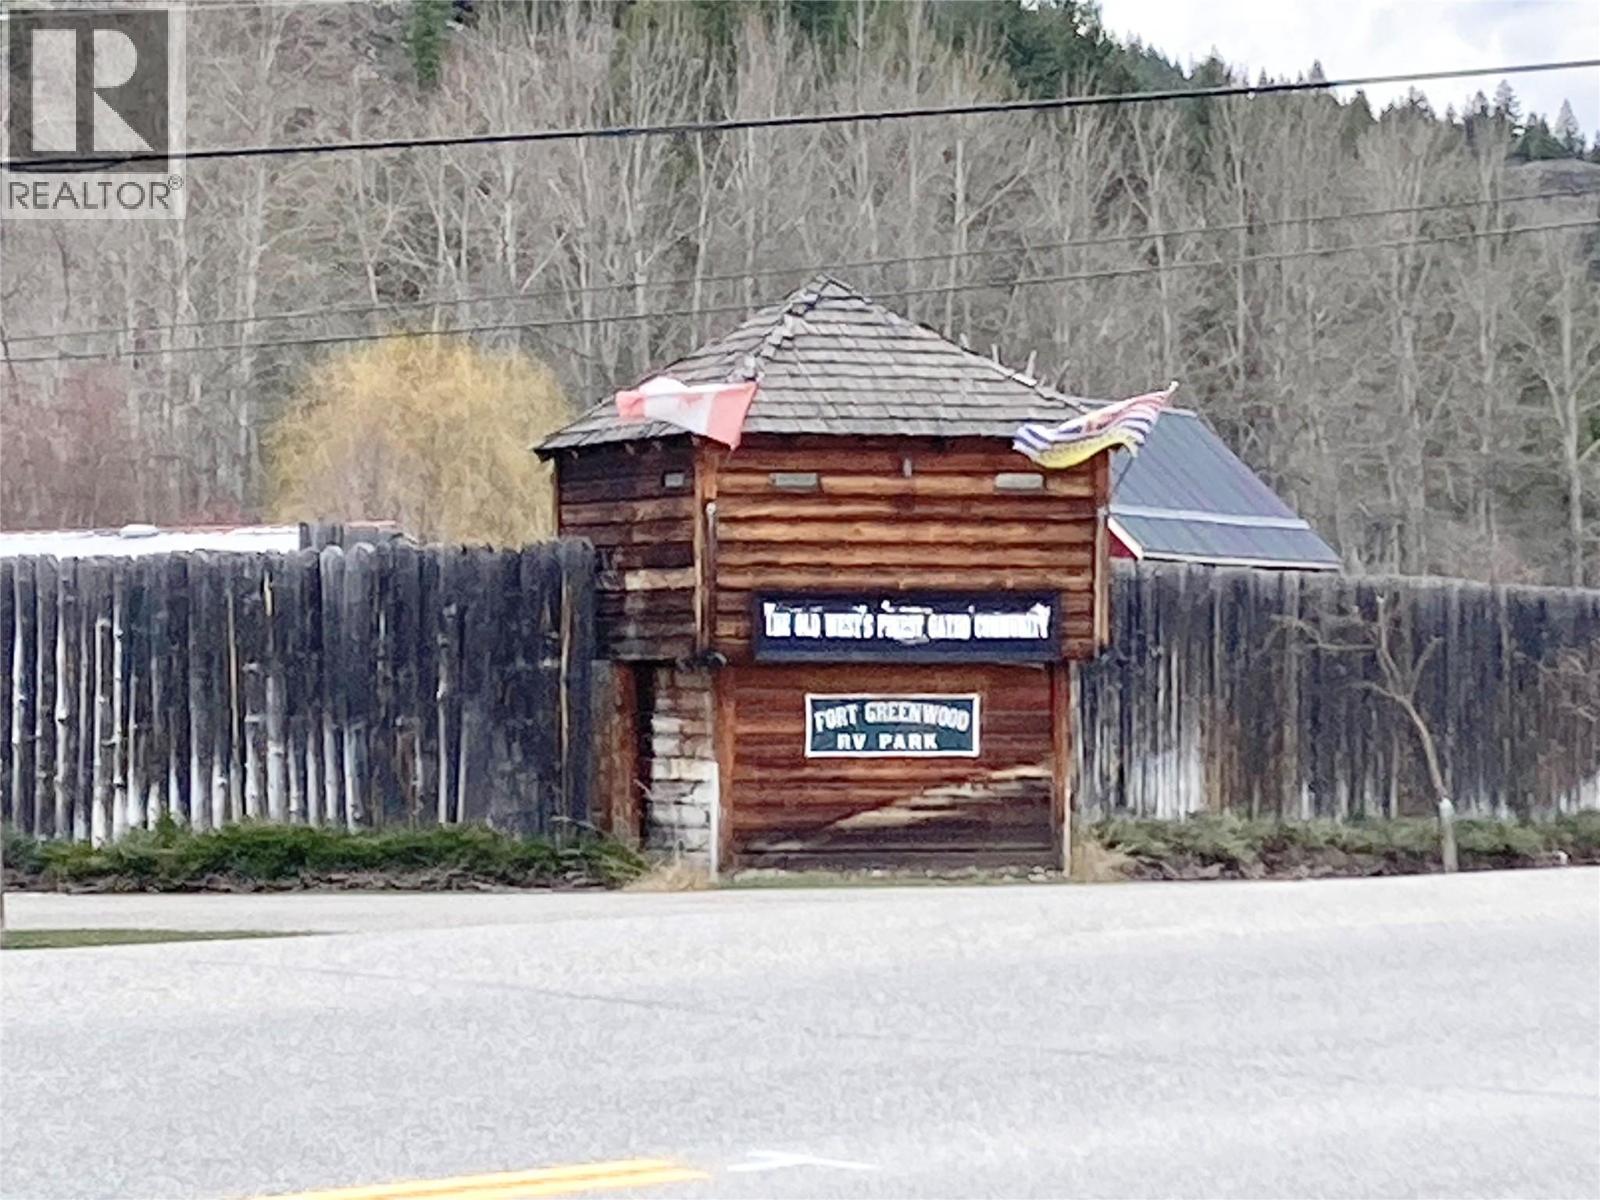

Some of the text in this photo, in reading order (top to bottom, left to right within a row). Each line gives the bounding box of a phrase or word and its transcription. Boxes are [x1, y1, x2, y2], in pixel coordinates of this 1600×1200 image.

[814, 701, 970, 732] FORT GREENWOOD
[837, 733, 938, 750] RV PARK
